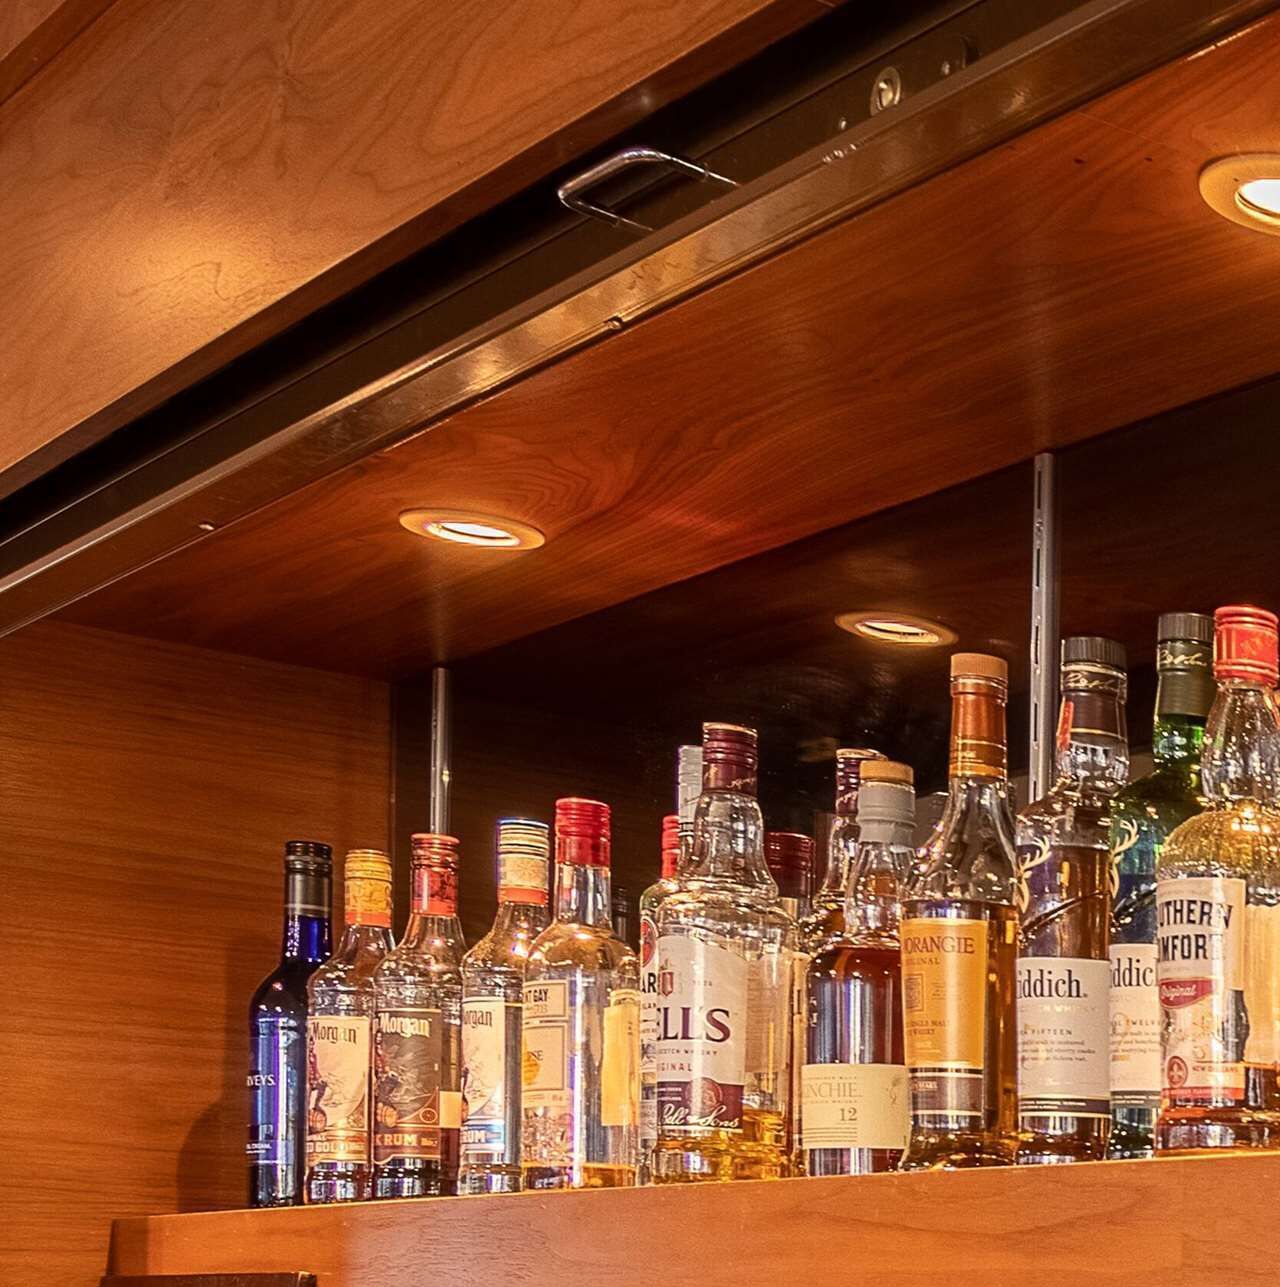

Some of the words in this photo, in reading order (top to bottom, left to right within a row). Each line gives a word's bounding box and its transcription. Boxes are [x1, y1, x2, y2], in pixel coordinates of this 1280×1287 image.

[533, 987, 549, 1003] GAY
[376, 1011, 431, 1038] Morgan
[839, 1106, 858, 1122] 12
[384, 1134, 418, 1147] RUM
